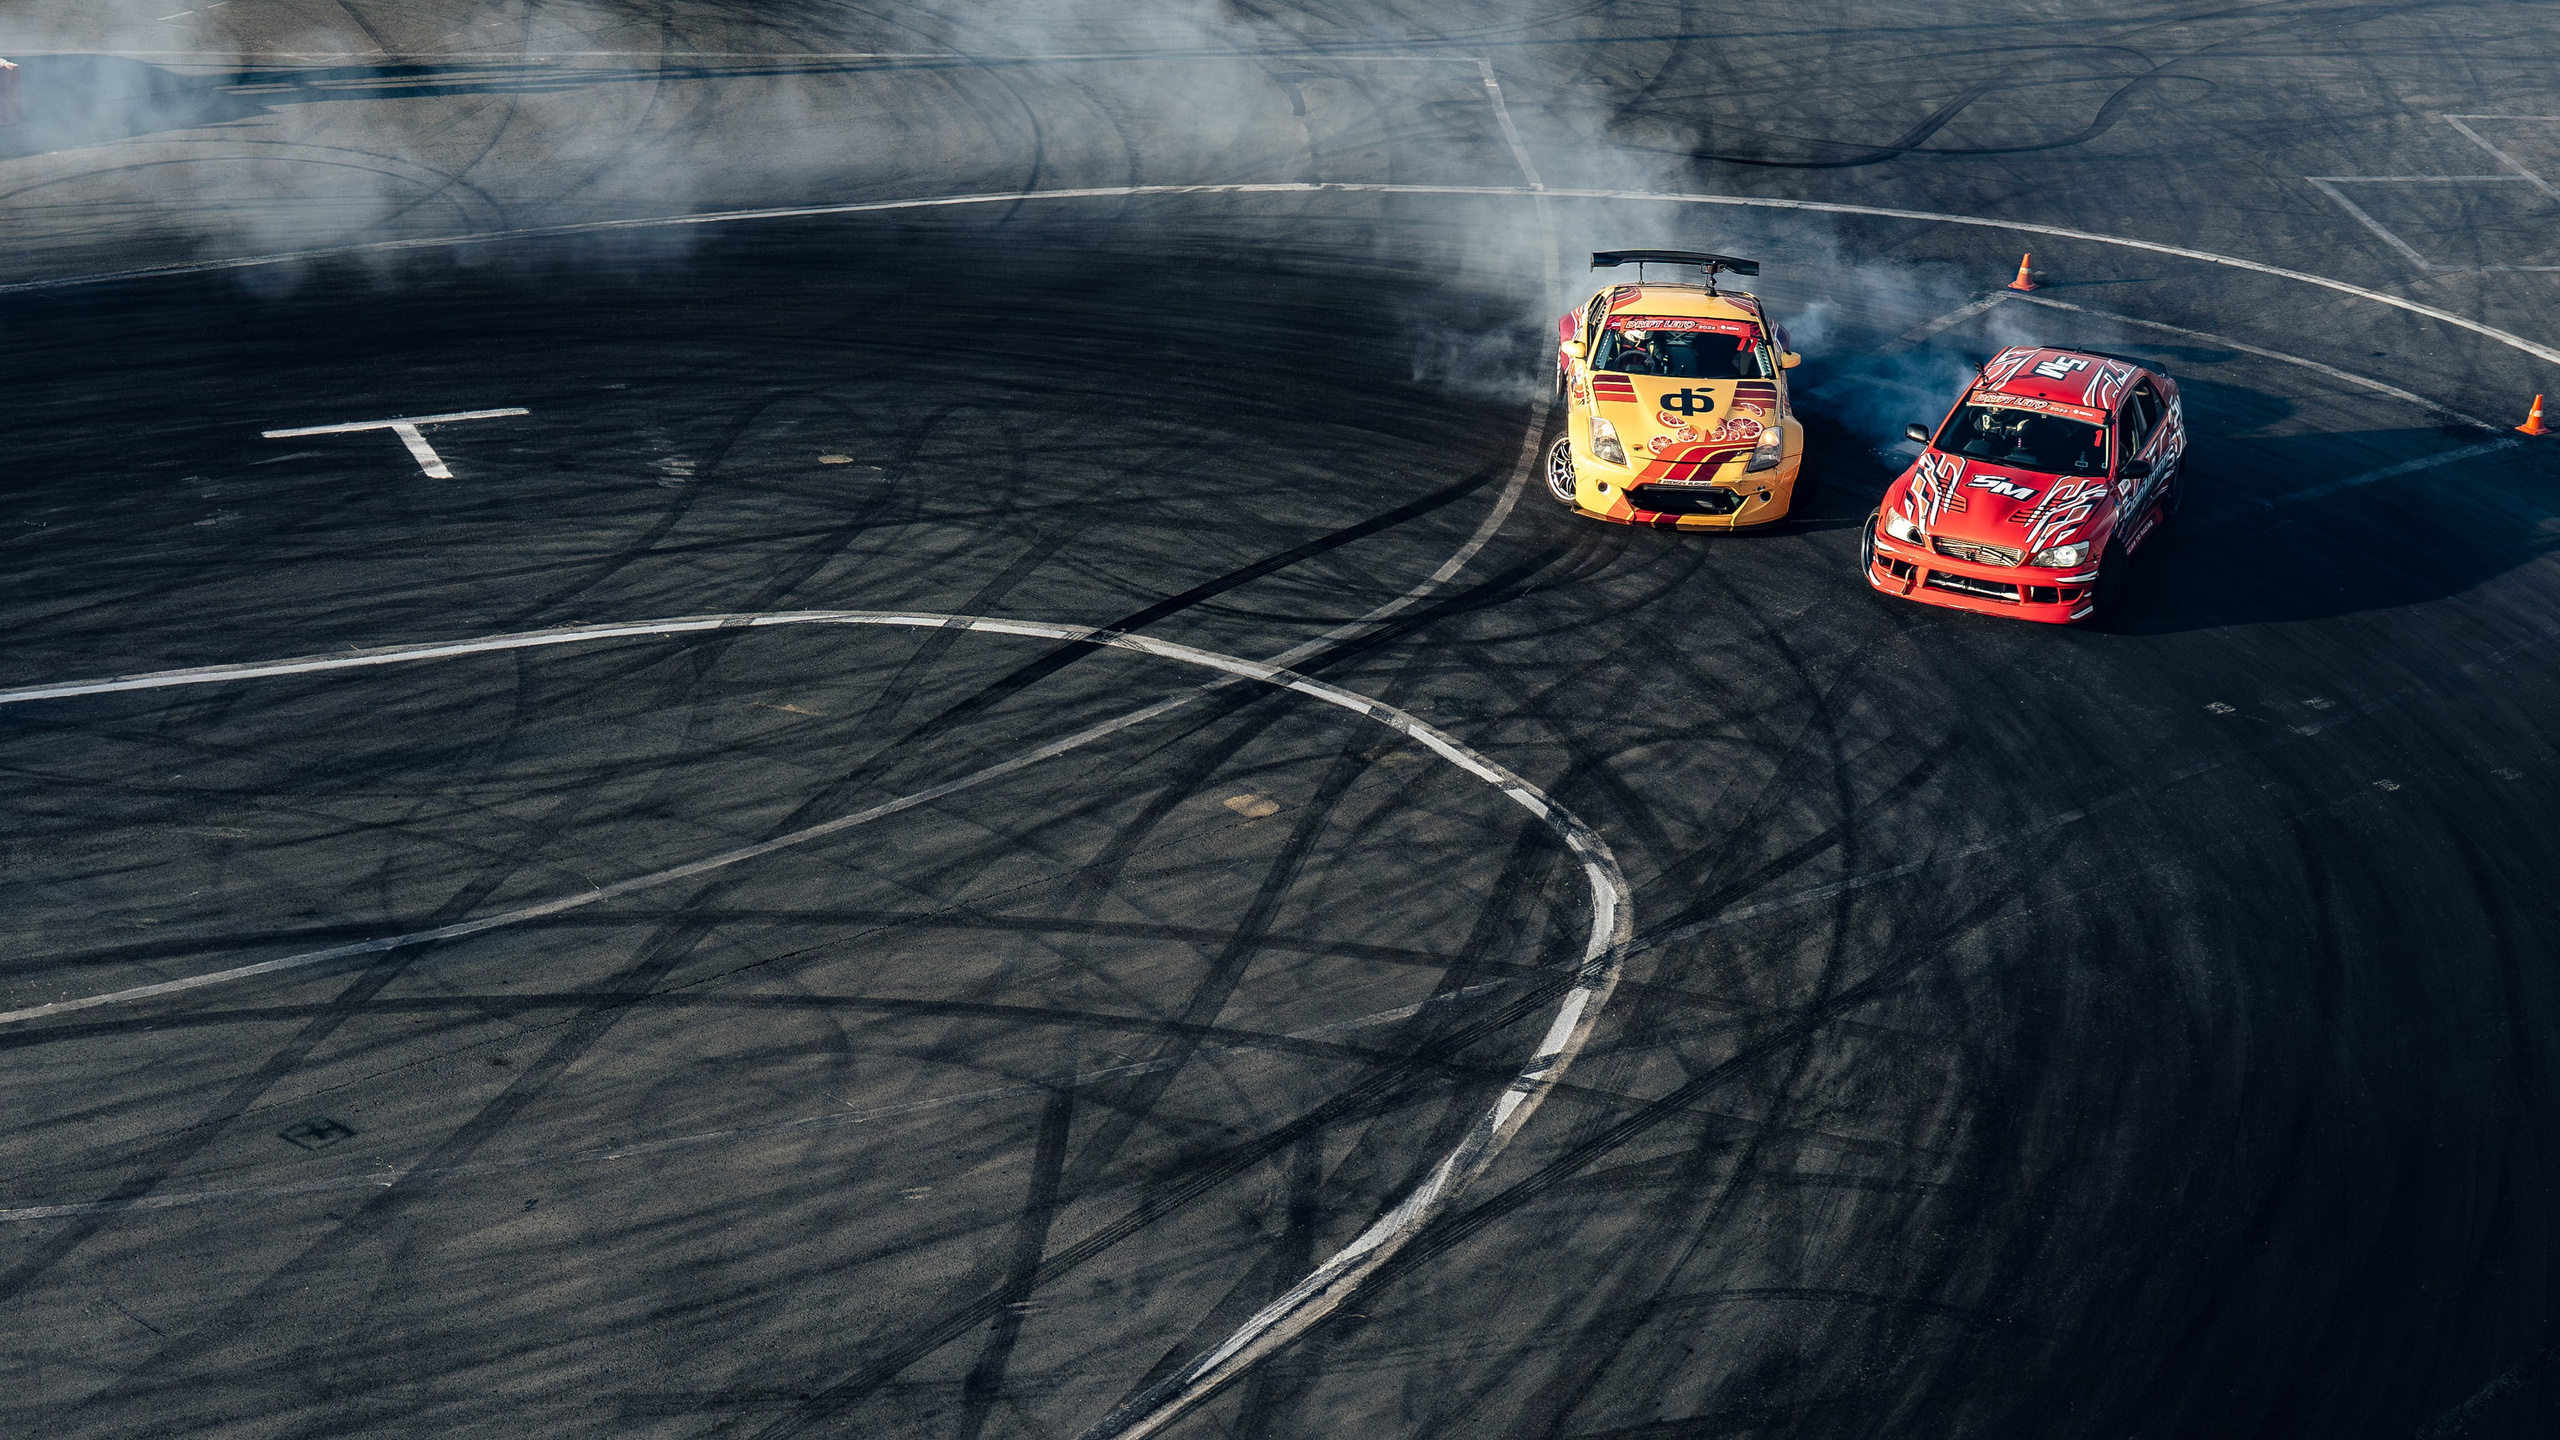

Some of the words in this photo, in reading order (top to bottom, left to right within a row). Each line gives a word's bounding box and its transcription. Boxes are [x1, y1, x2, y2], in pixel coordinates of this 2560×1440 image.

[1625, 320, 1664, 329] DRIFT
[1663, 320, 1696, 330] LETO
[1975, 393, 2015, 404] DRIFT
[2014, 397, 2048, 409] LETO
[2094, 429, 2103, 447] 1
